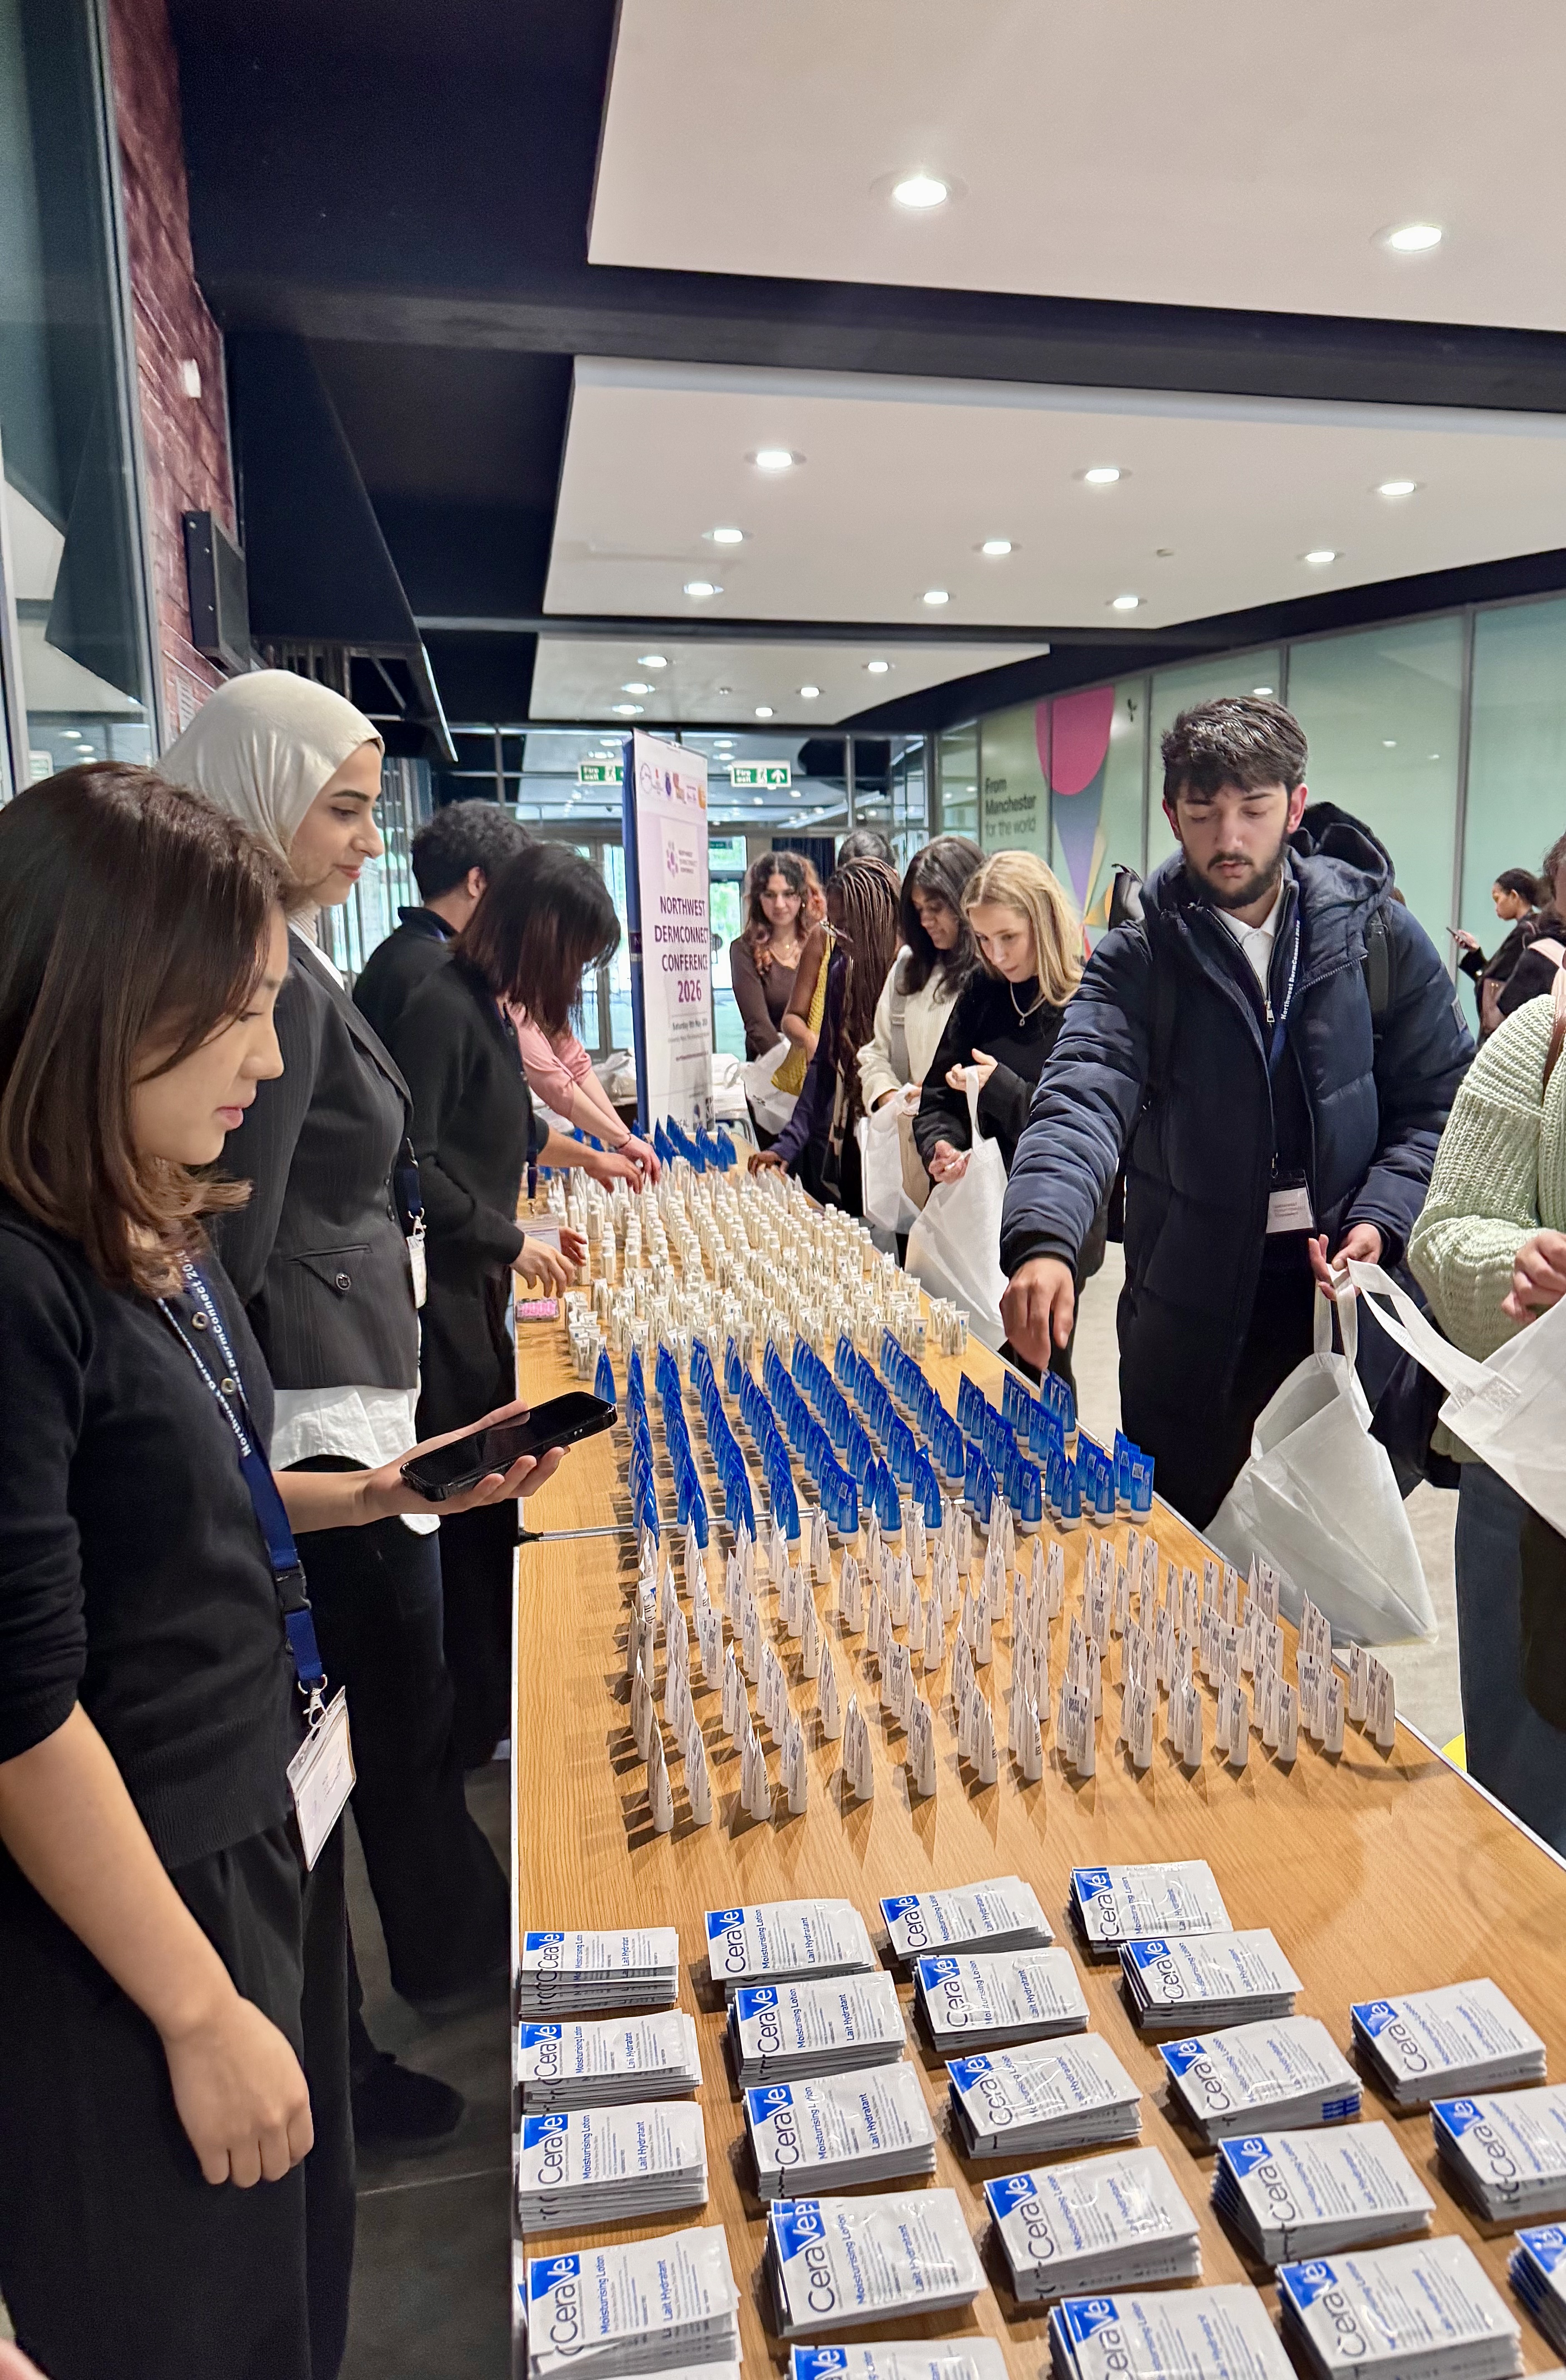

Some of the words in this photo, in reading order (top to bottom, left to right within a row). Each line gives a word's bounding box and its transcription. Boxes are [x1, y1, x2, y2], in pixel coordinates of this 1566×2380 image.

[985, 777, 1007, 793] From
[986, 794, 1037, 815] Manchester
[986, 821, 996, 838] for
[999, 820, 1011, 835] the
[1014, 814, 1036, 834] world
[660, 896, 705, 916] NORTHWEST
[655, 925, 708, 943] DERMCONNECT
[662, 954, 708, 971] CONFERENCE
[1281, 983, 1294, 1019] Northwest
[1289, 938, 1299, 983] DermConnect
[678, 980, 702, 1003] 2026
[191, 1280, 237, 1368] DermConnect
[895, 1896, 927, 1947] CeraVe
[1089, 1874, 1119, 1936] CeraVe
[538, 1934, 560, 1969] CeraVe
[719, 1911, 746, 1973] CeraVe
[758, 1927, 770, 1969] Moisturising
[802, 1917, 813, 1947] Hydratant
[806, 1948, 815, 1963] Lait
[1145, 1942, 1184, 1999] CeraVe
[790, 1989, 799, 2009] Lotion
[934, 1960, 968, 2027] CeraVe
[1019, 1969, 1035, 2004] Hydratant
[751, 1989, 780, 2053] CeraVe
[793, 2009, 805, 2048] Moisturising
[839, 1994, 852, 2024] Hydratant
[534, 2026, 558, 2077] CeraVe
[625, 2032, 635, 2056] Hydratant
[844, 2025, 854, 2041] Lait
[1368, 2003, 1427, 2072] CeraVe
[574, 2040, 584, 2073] Moisturising
[1178, 2042, 1230, 2110] CeraVe
[805, 2087, 818, 2109] Ltion
[859, 2093, 876, 2131] Hydratant
[637, 2121, 648, 2154] Hydratant
[763, 2088, 799, 2165] CeraVe
[811, 2109, 827, 2160] Moisturising
[871, 2132, 880, 2149] Lait
[1453, 2101, 1516, 2177] CeraVe
[538, 2114, 564, 2185] CeraVe
[583, 2134, 592, 2179] Moisturising
[639, 2156, 647, 2171] Lait
[1241, 2140, 1296, 2221] CeraVe
[1005, 2177, 1054, 2259] CeraVe
[658, 2259, 672, 2302] Hydratant
[793, 2213, 834, 2313] CeraVe
[846, 2241, 865, 2305] Moisturising
[547, 2258, 578, 2343] CeraVe
[597, 2277, 611, 2335] Moisturising
[661, 2303, 673, 2321] Lait
[1304, 2265, 1366, 2357] CeraVe
[1084, 2300, 1132, 2380] eraVe
